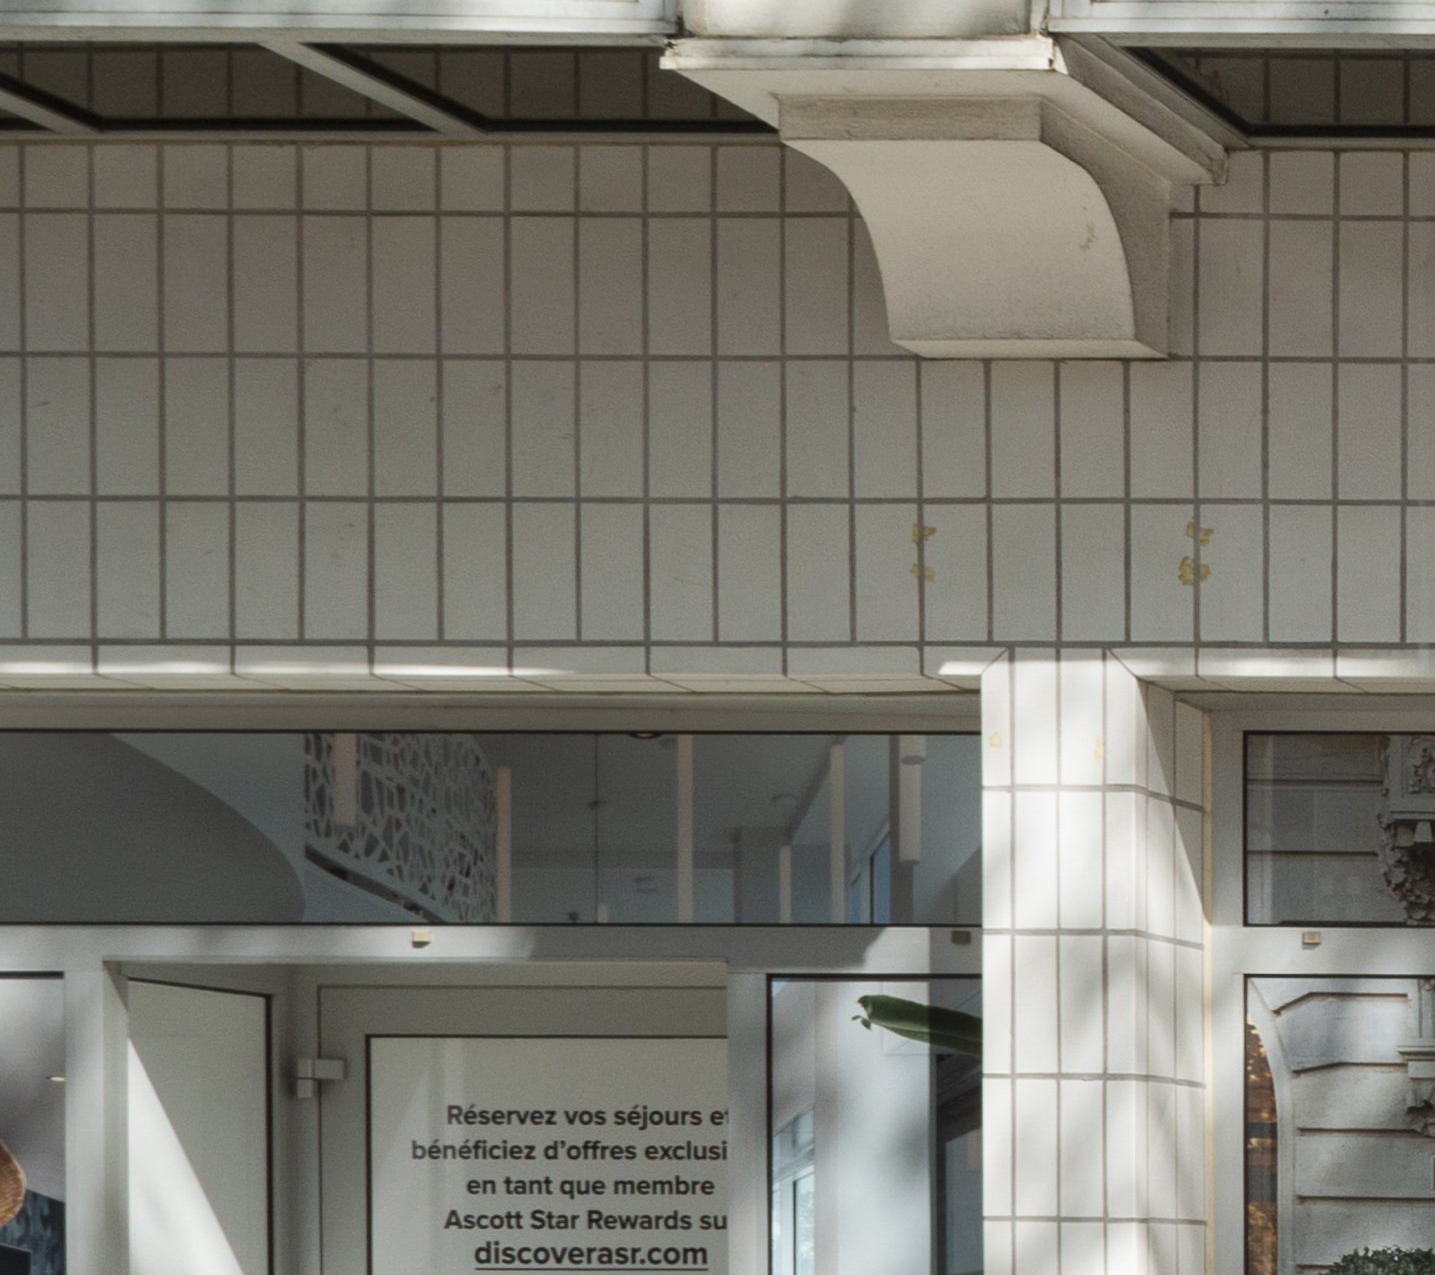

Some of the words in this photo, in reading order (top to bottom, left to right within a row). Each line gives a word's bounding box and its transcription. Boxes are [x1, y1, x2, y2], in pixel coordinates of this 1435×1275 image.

[447, 1105, 557, 1126] Réservez
[565, 1109, 606, 1126] vos
[614, 1105, 702, 1131] séjours
[710, 1109, 728, 1126] e
[412, 1139, 536, 1160] bénéficiez
[544, 1139, 637, 1160] d’offres
[644, 1139, 728, 1160] exclusi
[467, 1180, 496, 1195] en
[504, 1176, 553, 1195] tant
[560, 1180, 606, 1200] que
[614, 1176, 715, 1195] membre
[444, 1210, 523, 1229] Ascott
[530, 1210, 579, 1229] Star
[587, 1210, 692, 1229] Rewards
[700, 1215, 728, 1230] su
[475, 1241, 708, 1265] discoverasr.com
